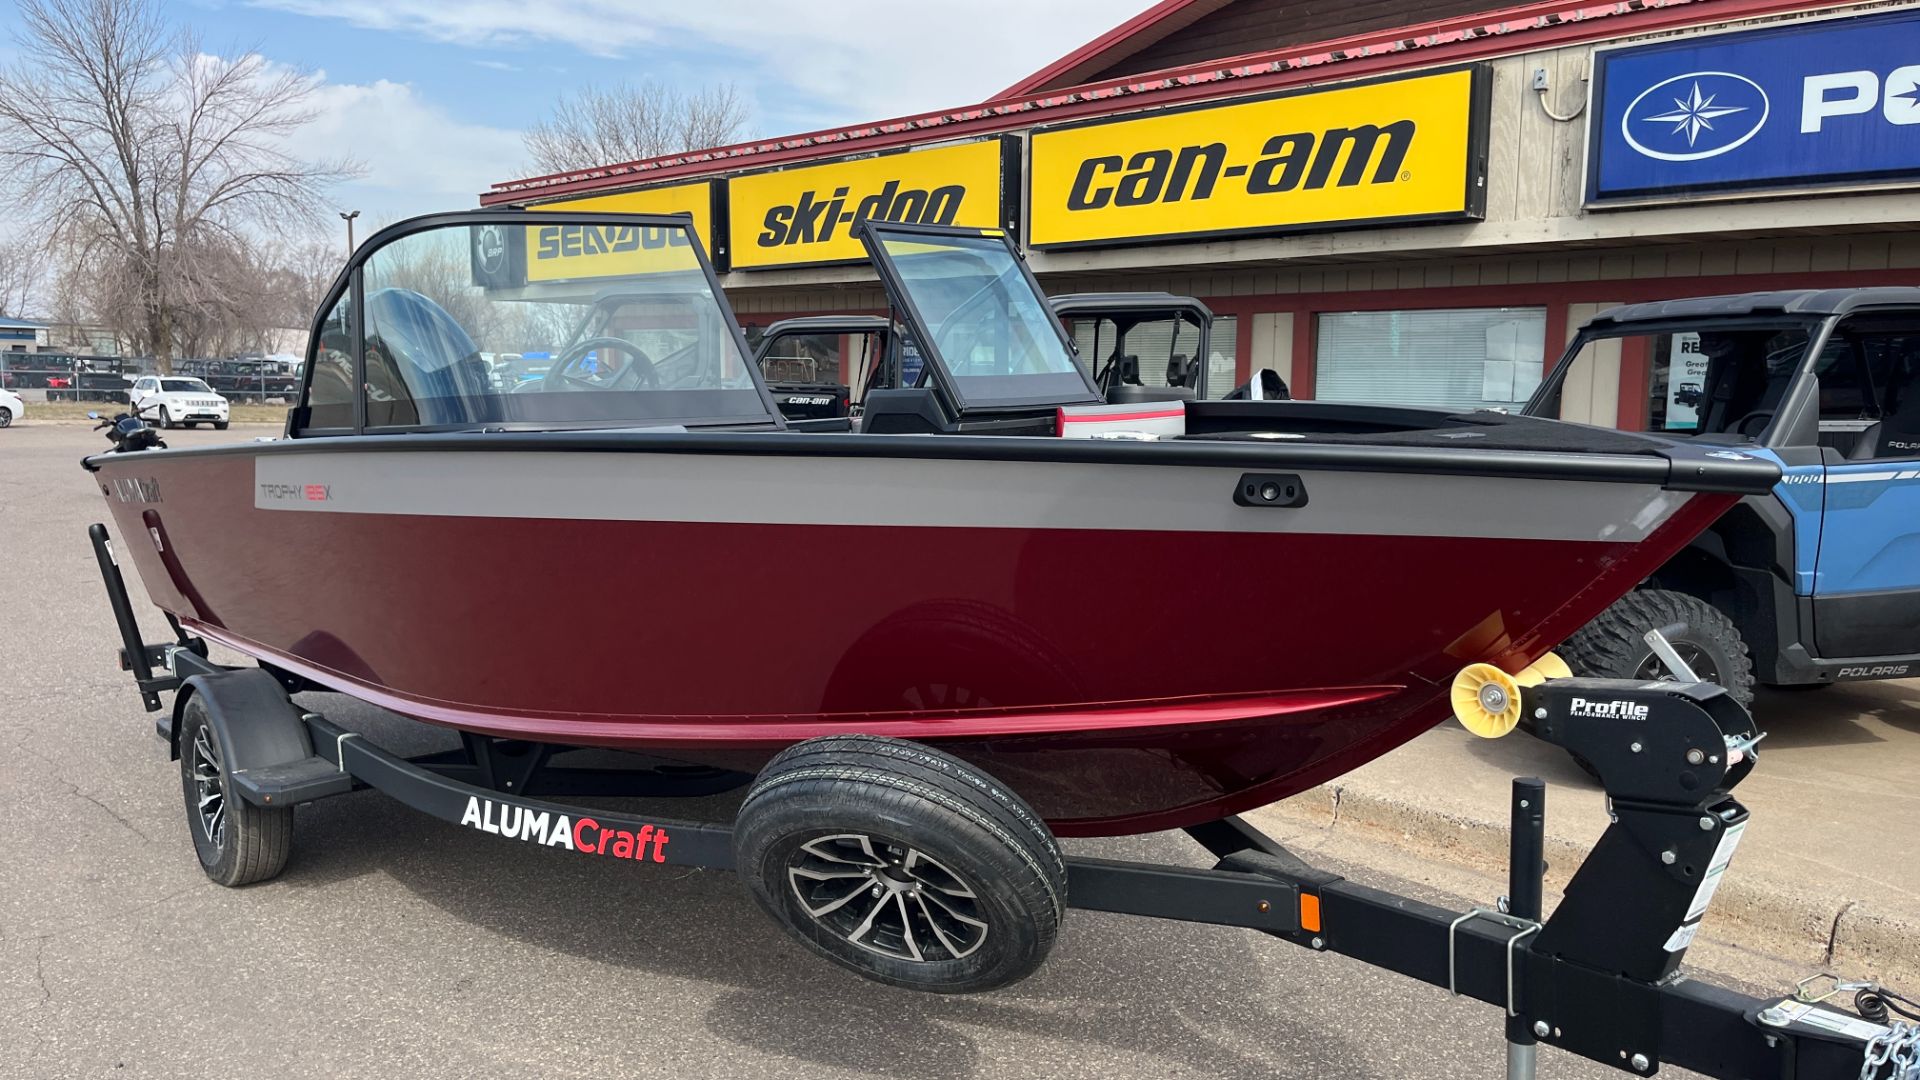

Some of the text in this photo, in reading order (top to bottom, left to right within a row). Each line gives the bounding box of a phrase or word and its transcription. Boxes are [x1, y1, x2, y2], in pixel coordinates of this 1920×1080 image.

[1067, 119, 1416, 211] can-am
[757, 180, 966, 247] ski-doo
[487, 247, 503, 258] BRP
[789, 396, 830, 406] can-am
[260, 484, 302, 499] TROPHY
[1838, 665, 1909, 678] POLARIS
[1570, 698, 1649, 716] Profile
[1570, 710, 1620, 719] PERFORMANCE
[461, 796, 670, 863] ALUMACraft
